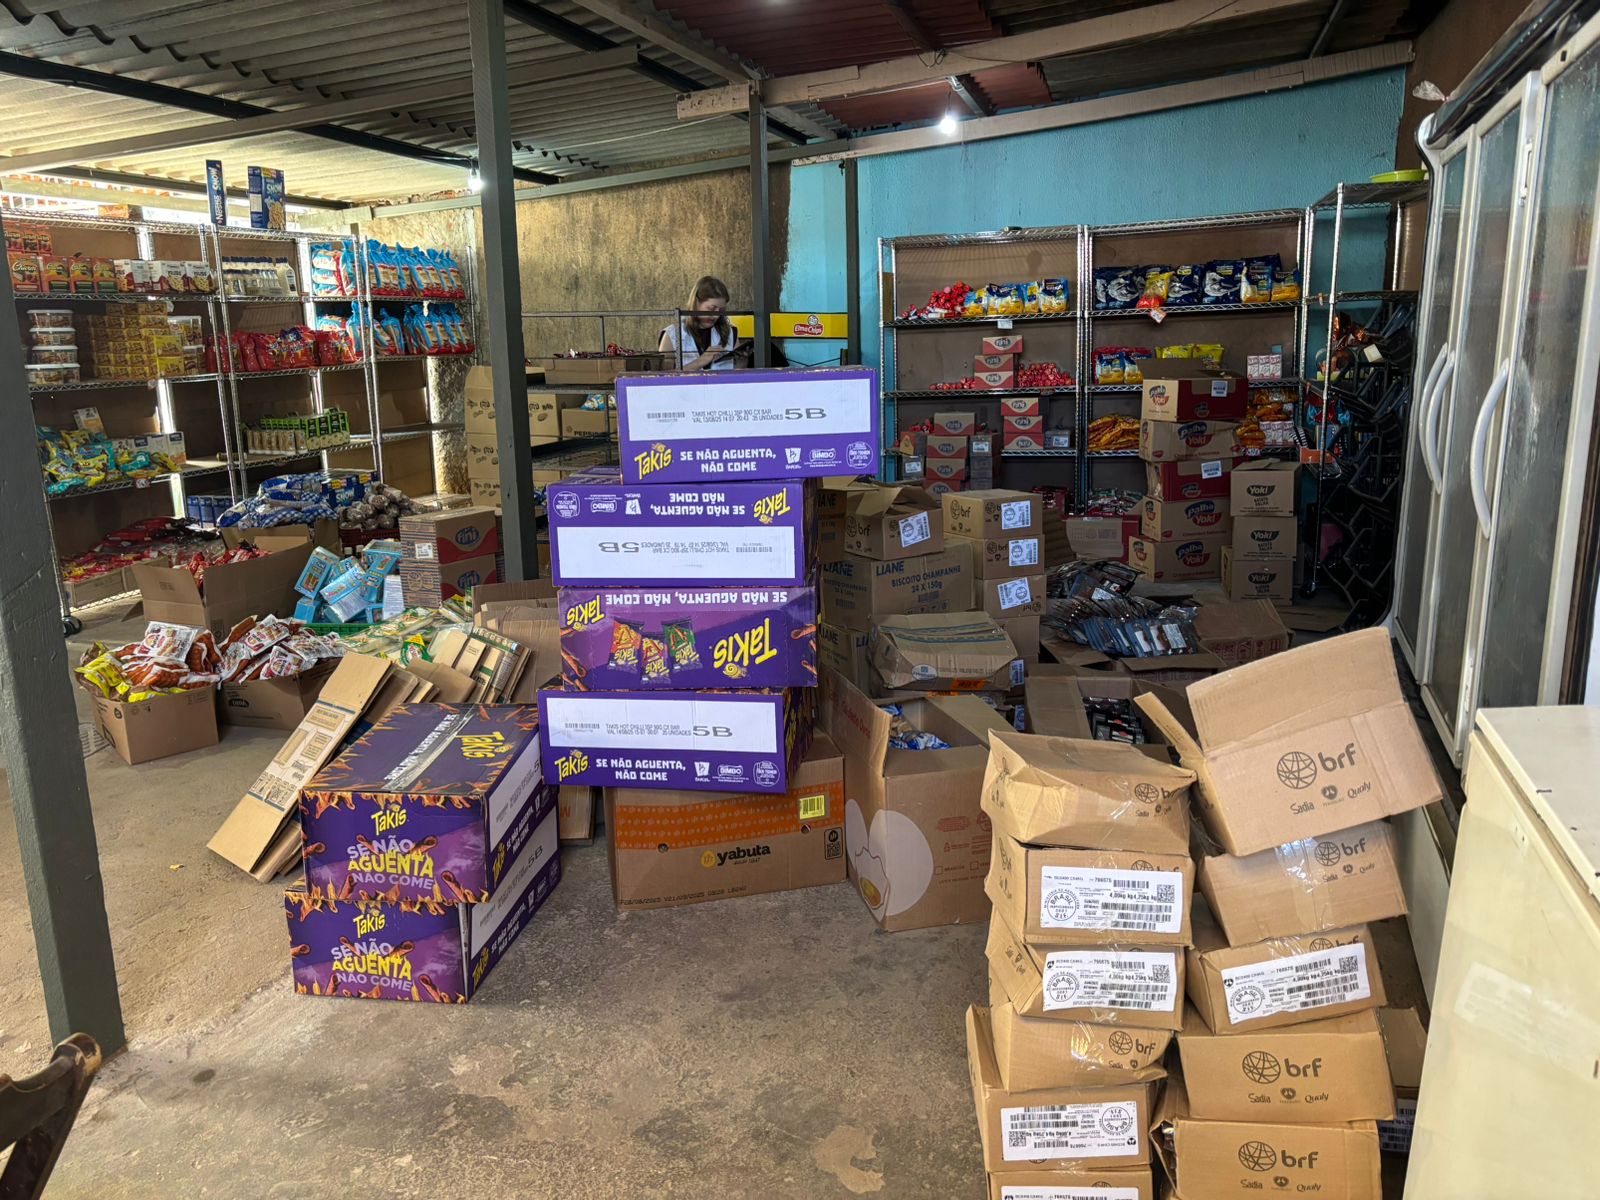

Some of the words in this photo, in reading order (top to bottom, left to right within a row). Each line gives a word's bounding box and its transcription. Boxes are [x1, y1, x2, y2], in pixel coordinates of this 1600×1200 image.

[784, 407, 828, 420] 5B
[680, 451, 694, 461] SE
[696, 449, 719, 460] NÃO
[722, 448, 777, 460] AGUENTA,
[634, 444, 673, 480] Takis
[701, 461, 725, 473] NÃO
[727, 461, 758, 472] COME
[1249, 485, 1268, 495] Yoki
[669, 493, 699, 502] COME
[702, 493, 726, 505] NÃO
[817, 493, 837, 507] IANE
[650, 504, 704, 516] AGUENTA,
[706, 505, 730, 517] NÃO
[732, 505, 746, 515] SE
[753, 488, 792, 522] Takis
[960, 505, 971, 518] brf
[456, 527, 478, 544] fini
[858, 523, 871, 537] brf
[1253, 531, 1272, 541] Yoki
[598, 541, 640, 553] 5B
[823, 561, 854, 577] LIANE
[876, 561, 905, 577] LIANE
[891, 574, 921, 588] BISCOITO
[922, 565, 961, 580] CHAMPANHE
[1250, 573, 1270, 583] Yoki
[605, 594, 641, 605] COME
[644, 593, 671, 607] NÃO
[674, 592, 738, 604] AGUENTA,
[742, 592, 769, 605] NÃO
[772, 592, 788, 603] SE
[566, 595, 605, 627] Takis
[713, 617, 777, 668] Takis
[692, 725, 734, 738] 5B
[455, 731, 506, 759] Takis
[1318, 742, 1356, 772] brf
[554, 750, 589, 782] Takis
[595, 758, 608, 768] SE
[610, 758, 633, 769] NÃO
[635, 759, 687, 771] AGUENTA,
[615, 769, 637, 780] NÃO
[640, 771, 668, 781] COME
[1290, 801, 1315, 815] Sadia
[1347, 781, 1371, 799] Qualy
[371, 808, 407, 836] Takis
[346, 843, 370, 859] SE
[372, 834, 414, 853] NÃO
[1341, 837, 1366, 856] brf
[716, 844, 771, 866] yabuta
[348, 850, 434, 878] AGUENTA
[388, 874, 434, 890] COME
[1050, 893, 1073, 906] BRASIL
[353, 913, 386, 938] Takis
[330, 944, 353, 960] SE
[353, 937, 393, 956] NÃO
[332, 952, 412, 981] AGUENTA
[370, 975, 412, 992] COME
[1052, 975, 1074, 988] BRASIL
[1235, 990, 1259, 1004] BRASIL
[1135, 1038, 1156, 1056] brf
[1284, 1057, 1322, 1078] brf
[1248, 1093, 1272, 1104] Sadia
[1304, 1092, 1329, 1104] Qualy
[1281, 1149, 1319, 1169] brf
[1240, 1178, 1264, 1190] Sadia
[1296, 1182, 1322, 1193] Qualy
